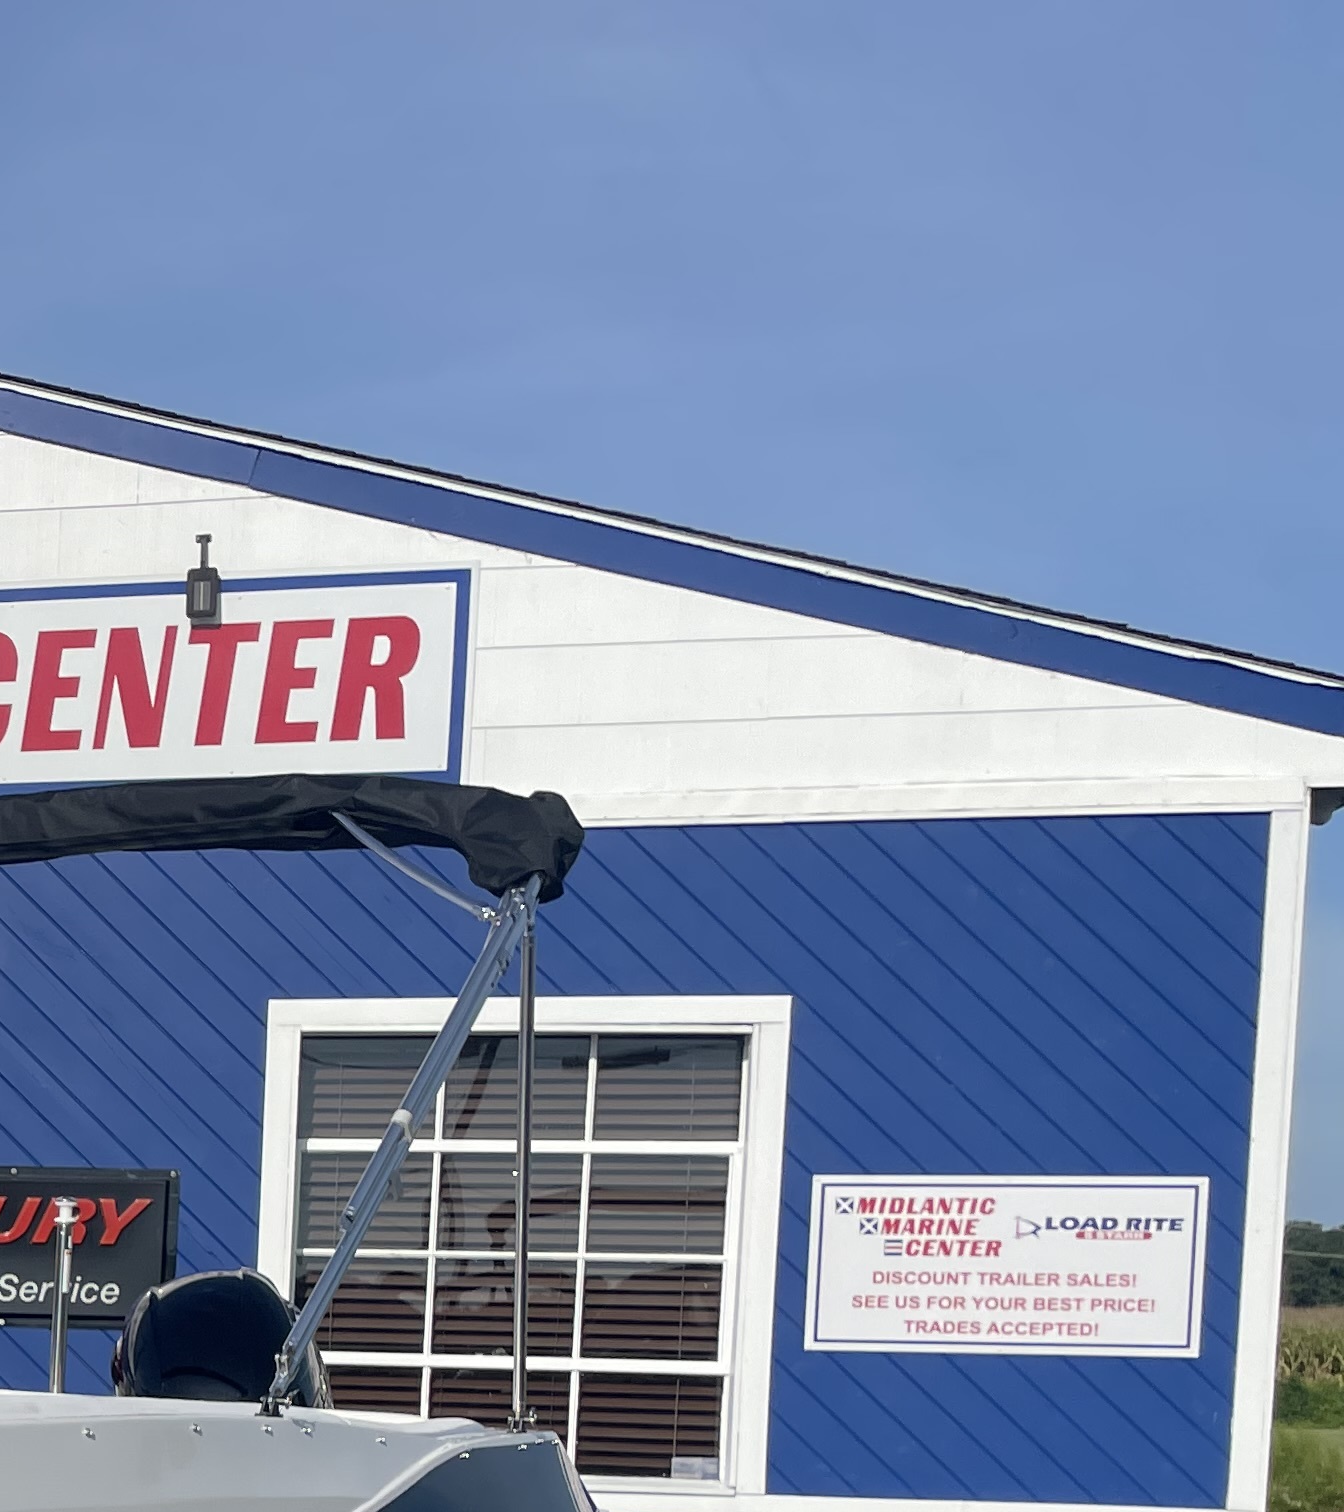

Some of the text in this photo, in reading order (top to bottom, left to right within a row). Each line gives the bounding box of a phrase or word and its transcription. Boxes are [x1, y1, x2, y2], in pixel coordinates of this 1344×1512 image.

[856, 1196, 996, 1216] MIDLANTIC
[880, 1218, 981, 1236] MARINE
[1045, 1216, 1185, 1232] LOAD RITE
[904, 1240, 1002, 1258] CENTER
[872, 1271, 1138, 1288] DISCOUNT TRAILER SALES!
[851, 1295, 1156, 1313] SEE US FOR YOUR BEST PRICE!
[904, 1320, 1100, 1337] TRADES ACCEPTED!
